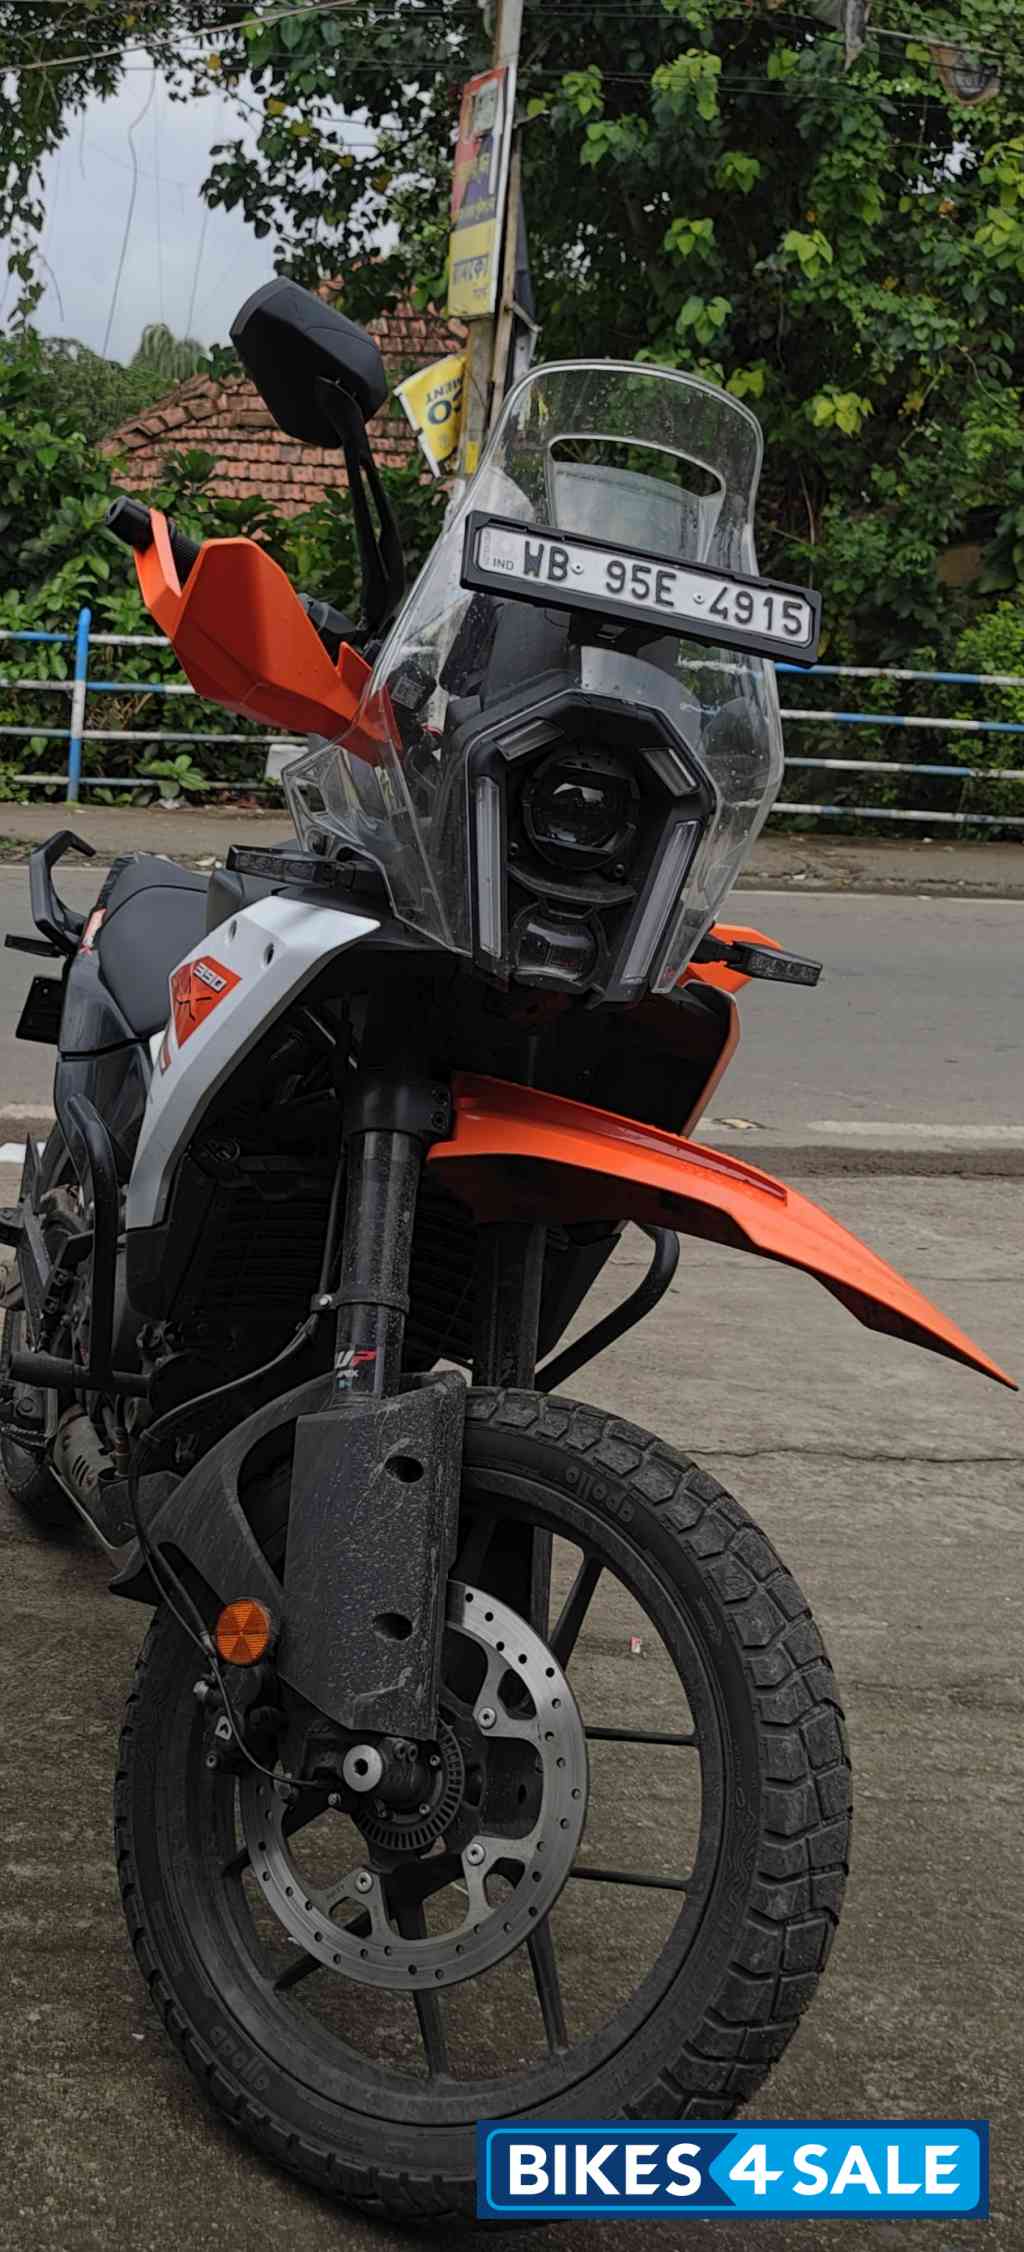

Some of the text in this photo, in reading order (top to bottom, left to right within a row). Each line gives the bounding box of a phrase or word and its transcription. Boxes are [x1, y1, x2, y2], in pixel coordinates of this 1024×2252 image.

[493, 557, 514, 570] IND
[523, 541, 570, 581] WB
[606, 559, 677, 607] 95E
[709, 586, 804, 636] 4915
